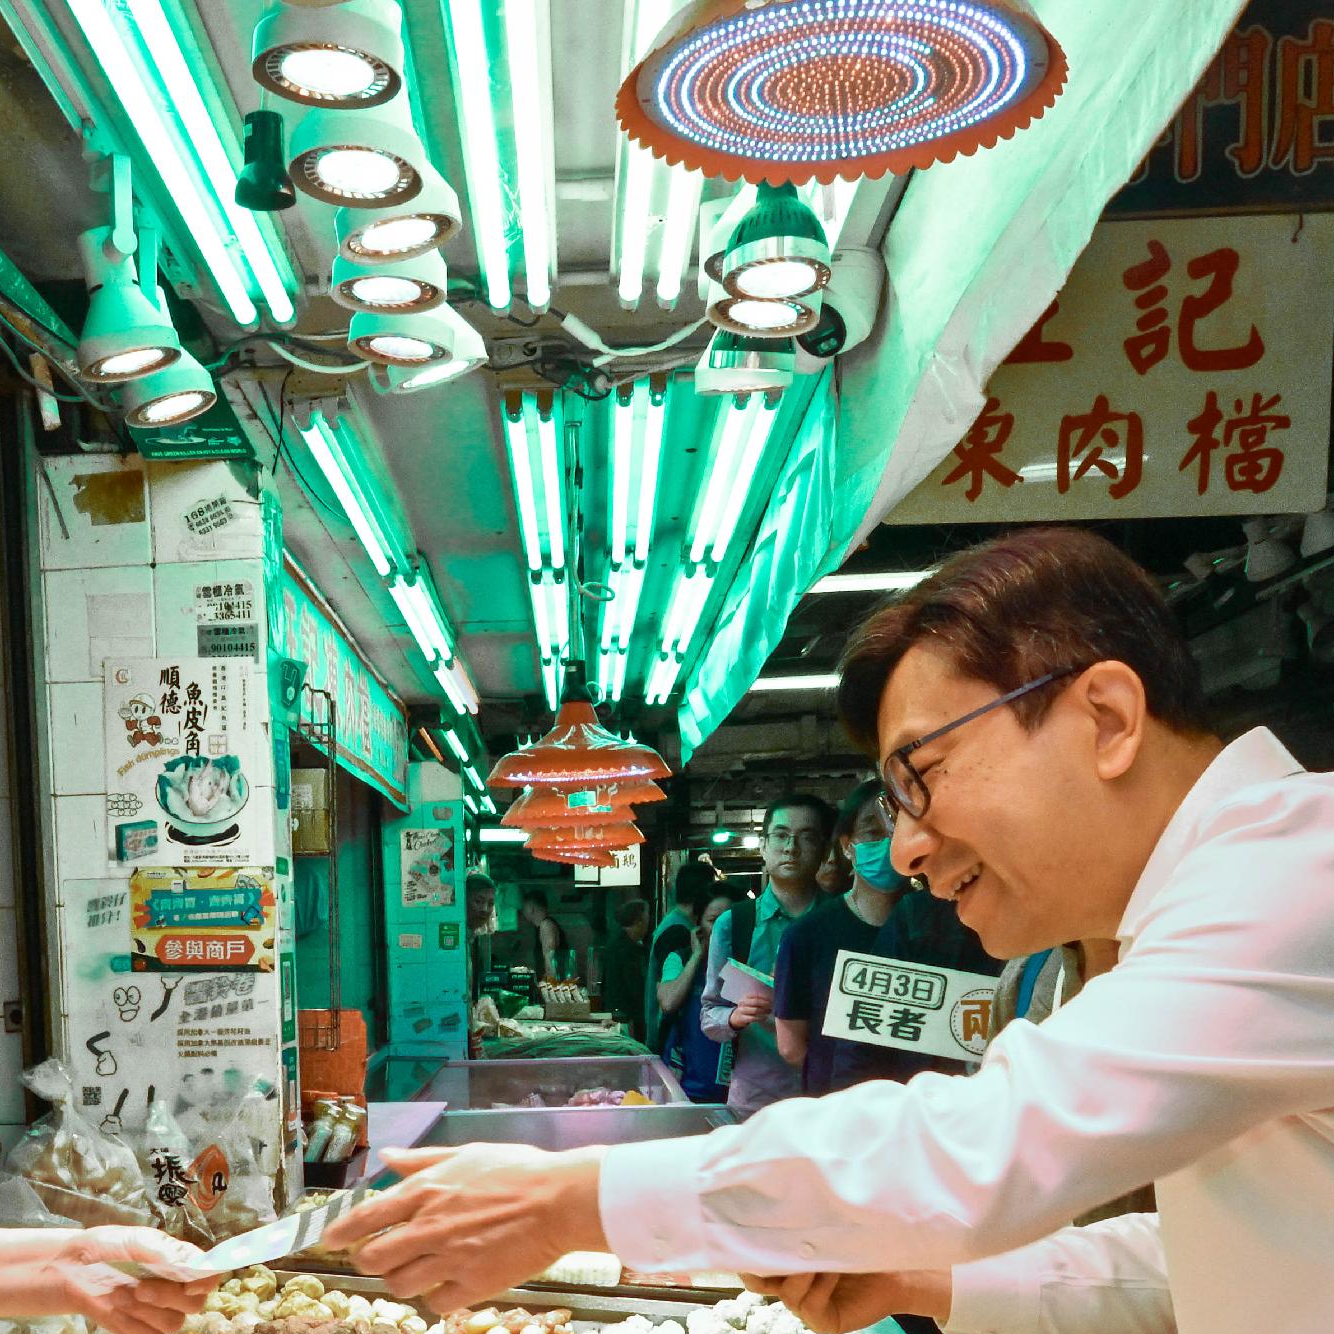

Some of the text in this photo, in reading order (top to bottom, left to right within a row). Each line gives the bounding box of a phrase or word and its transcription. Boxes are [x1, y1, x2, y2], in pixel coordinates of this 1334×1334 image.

[159, 665, 182, 715] 順德
[183, 681, 205, 757] 魚皮角
[164, 940, 245, 961] 參與商戶
[851, 968, 936, 1001] 4月3日
[846, 1001, 927, 1042] 長者
